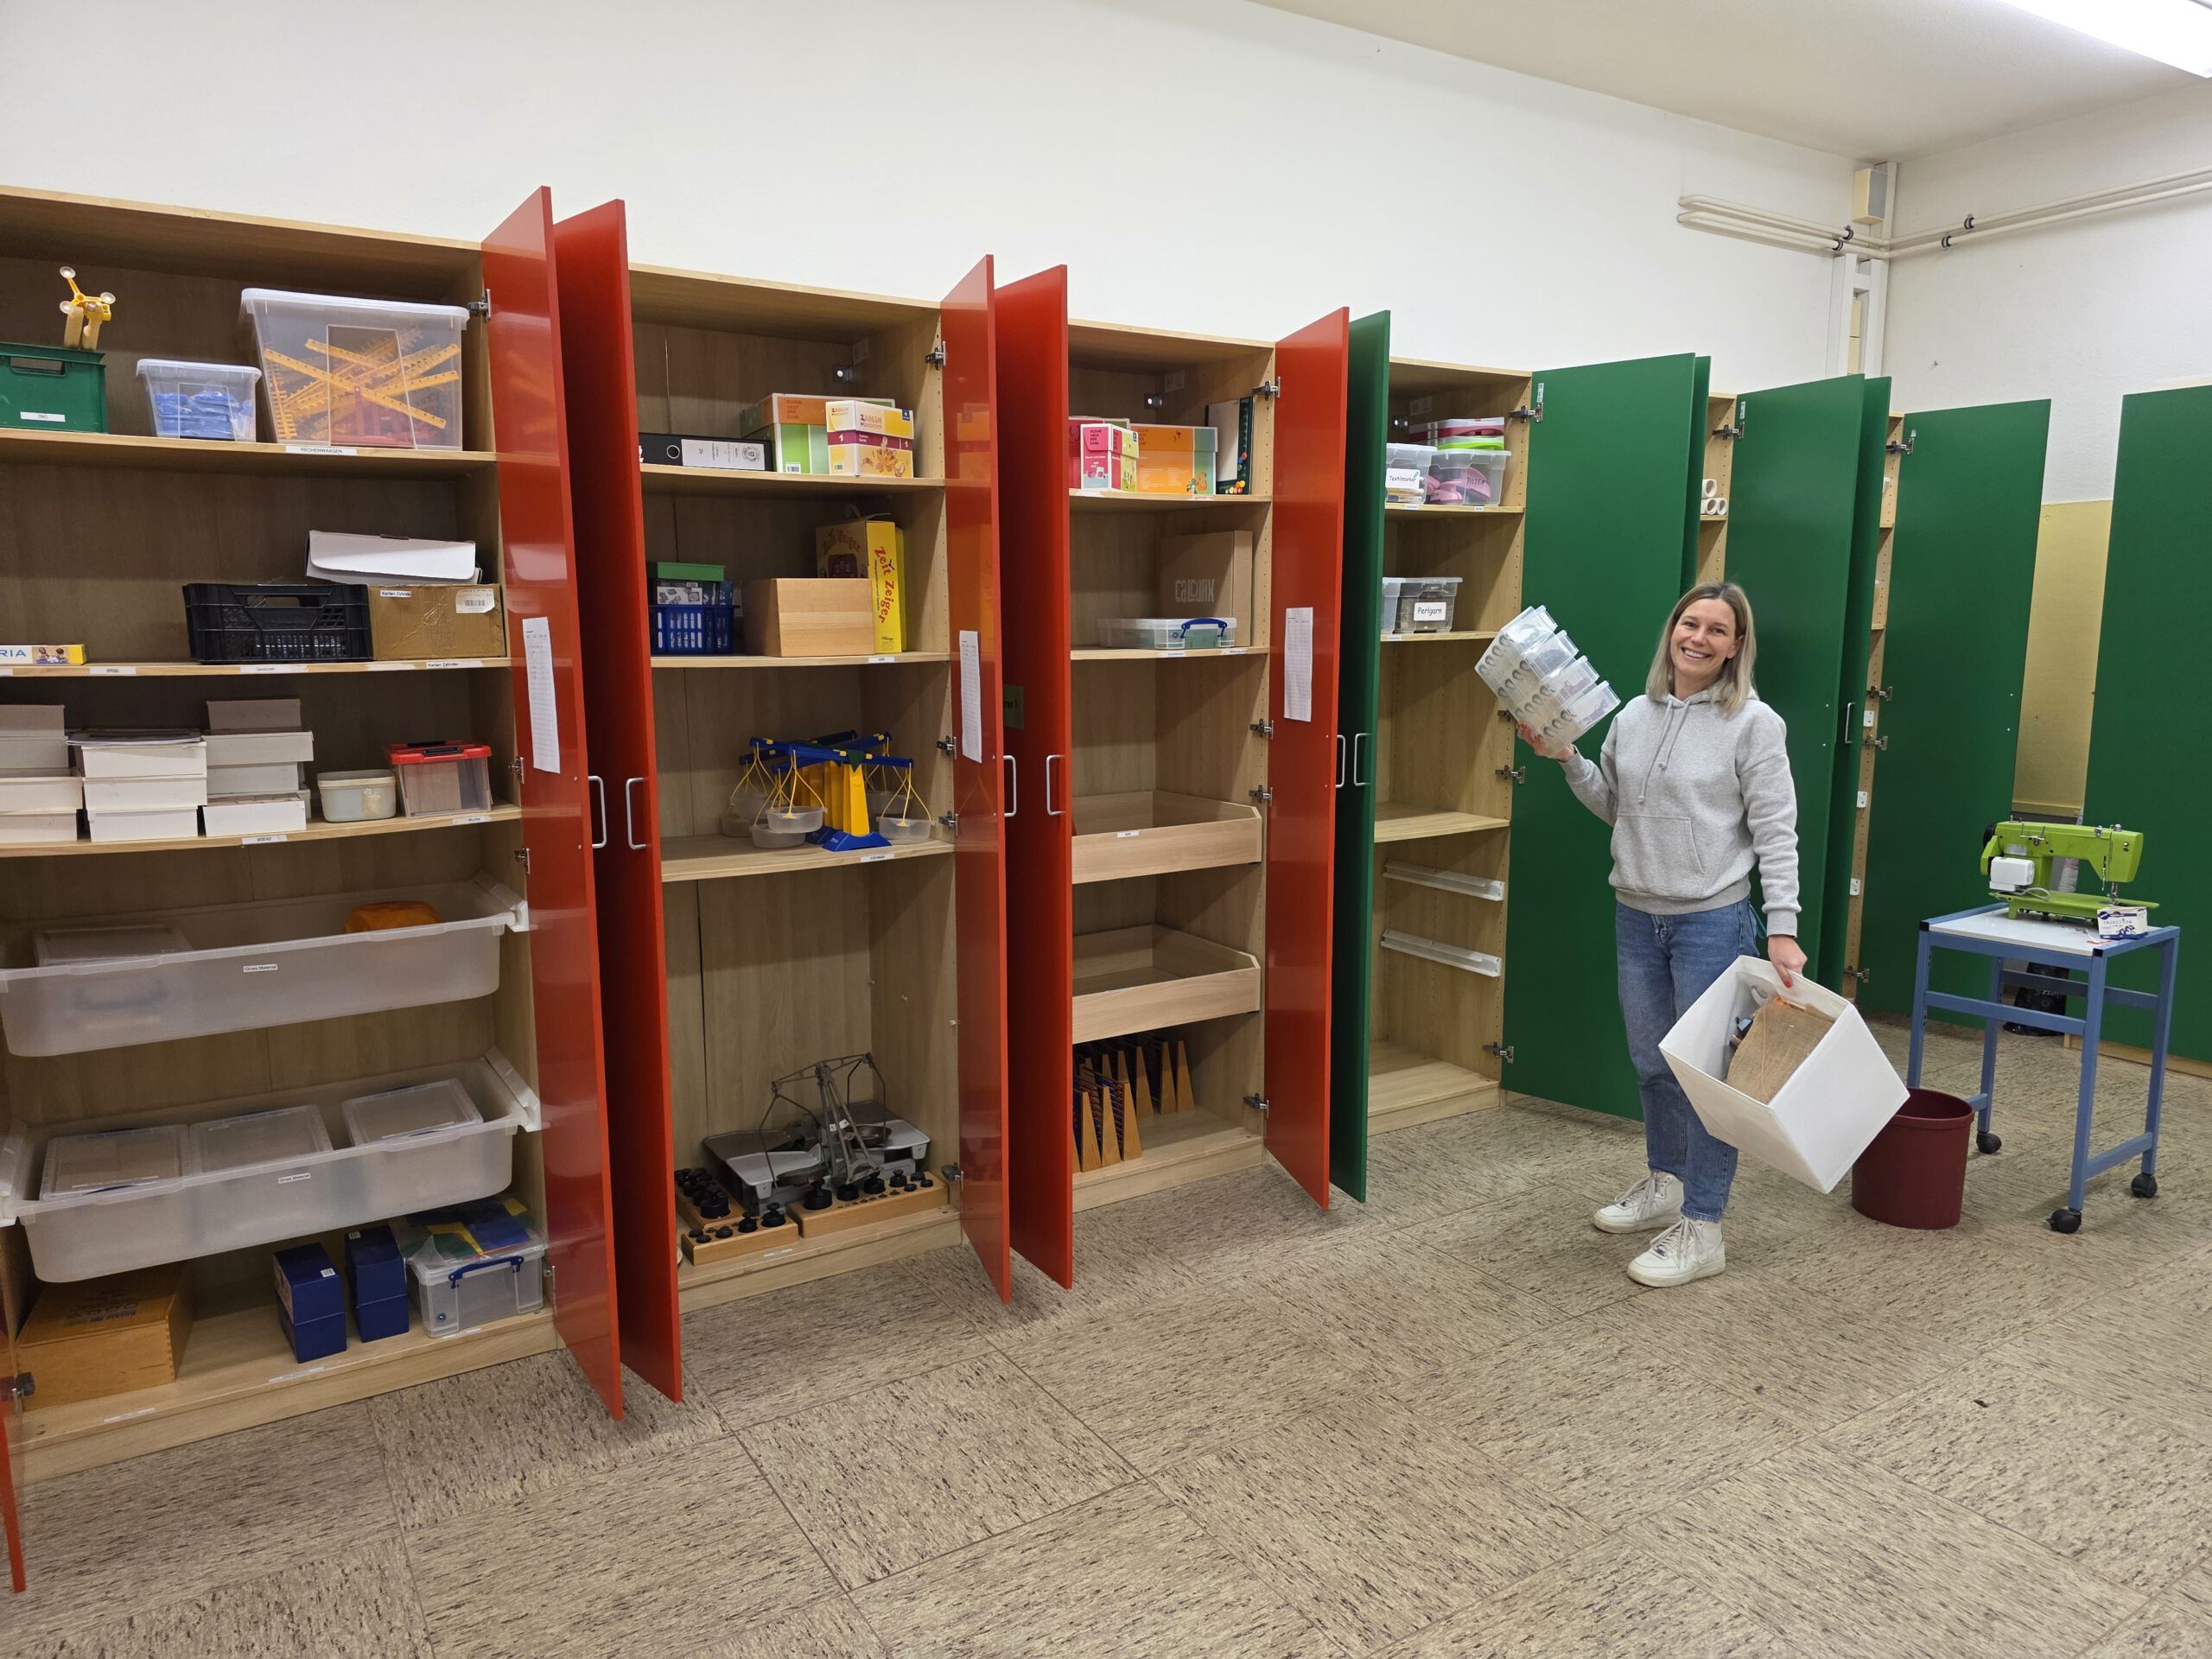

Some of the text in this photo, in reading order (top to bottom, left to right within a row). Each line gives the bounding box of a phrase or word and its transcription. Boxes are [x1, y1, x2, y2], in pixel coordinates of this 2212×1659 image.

[874, 546, 892, 576] Zeit
[877, 580, 894, 624] Zeiger
[1418, 607, 1442, 617] Perlgarn
